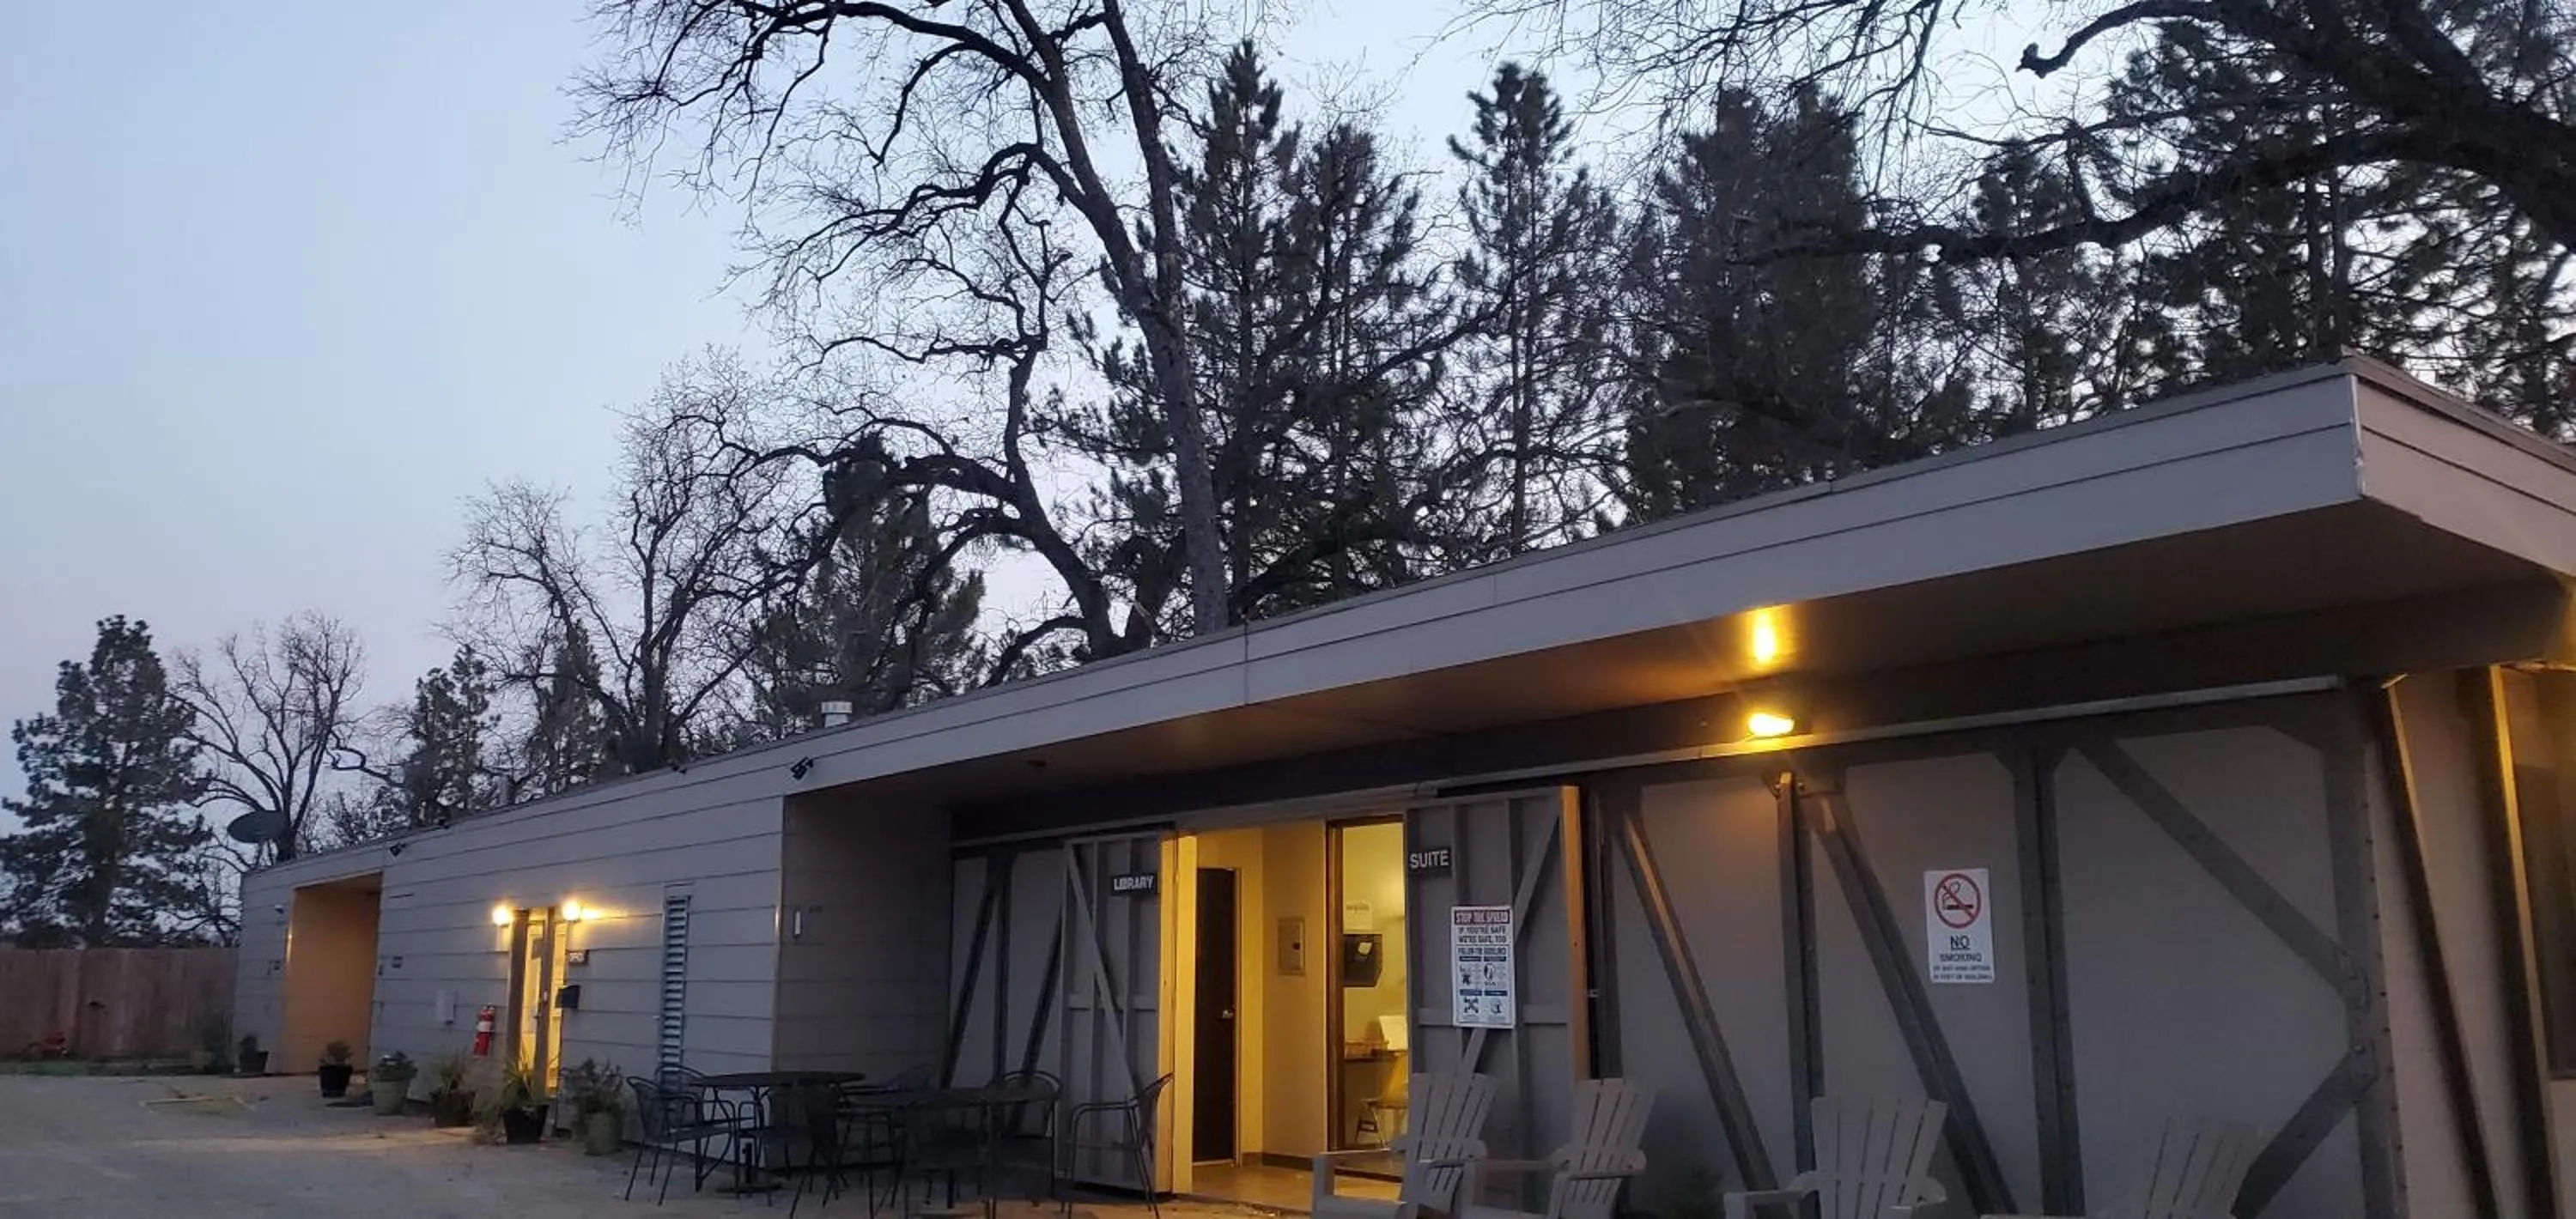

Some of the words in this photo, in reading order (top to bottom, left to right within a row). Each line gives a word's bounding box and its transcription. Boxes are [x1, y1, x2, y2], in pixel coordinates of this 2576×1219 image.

[1410, 850, 1449, 868] SUITE
[1114, 875, 1153, 890] LIBRARY
[1950, 935, 1970, 949] NO
[1940, 953, 1982, 962] SMOKING
